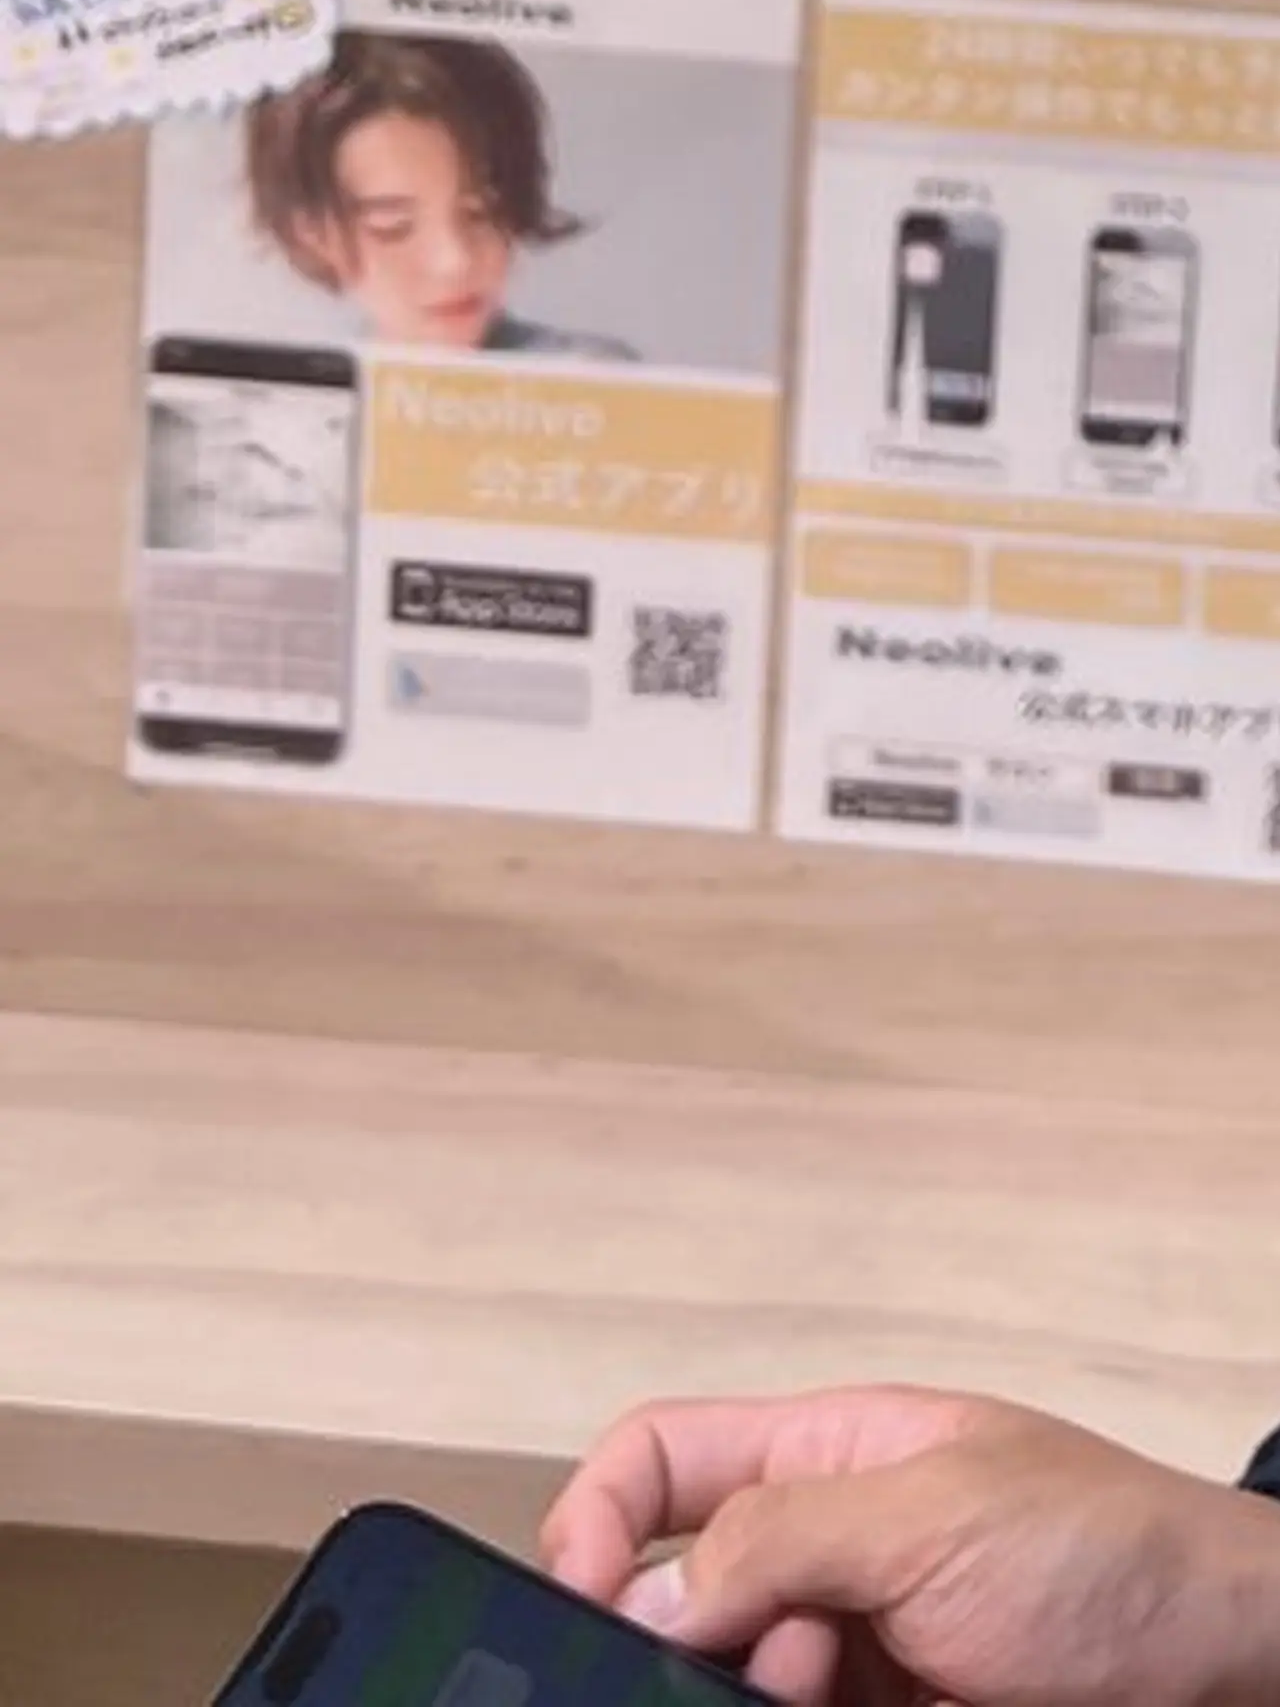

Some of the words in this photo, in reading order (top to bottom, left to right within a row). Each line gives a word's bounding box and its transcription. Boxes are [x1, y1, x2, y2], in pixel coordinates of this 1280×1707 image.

[386, 379, 608, 442] Neolive
[468, 453, 763, 522] 公式アプリ
[833, 625, 1064, 677] Neolive
